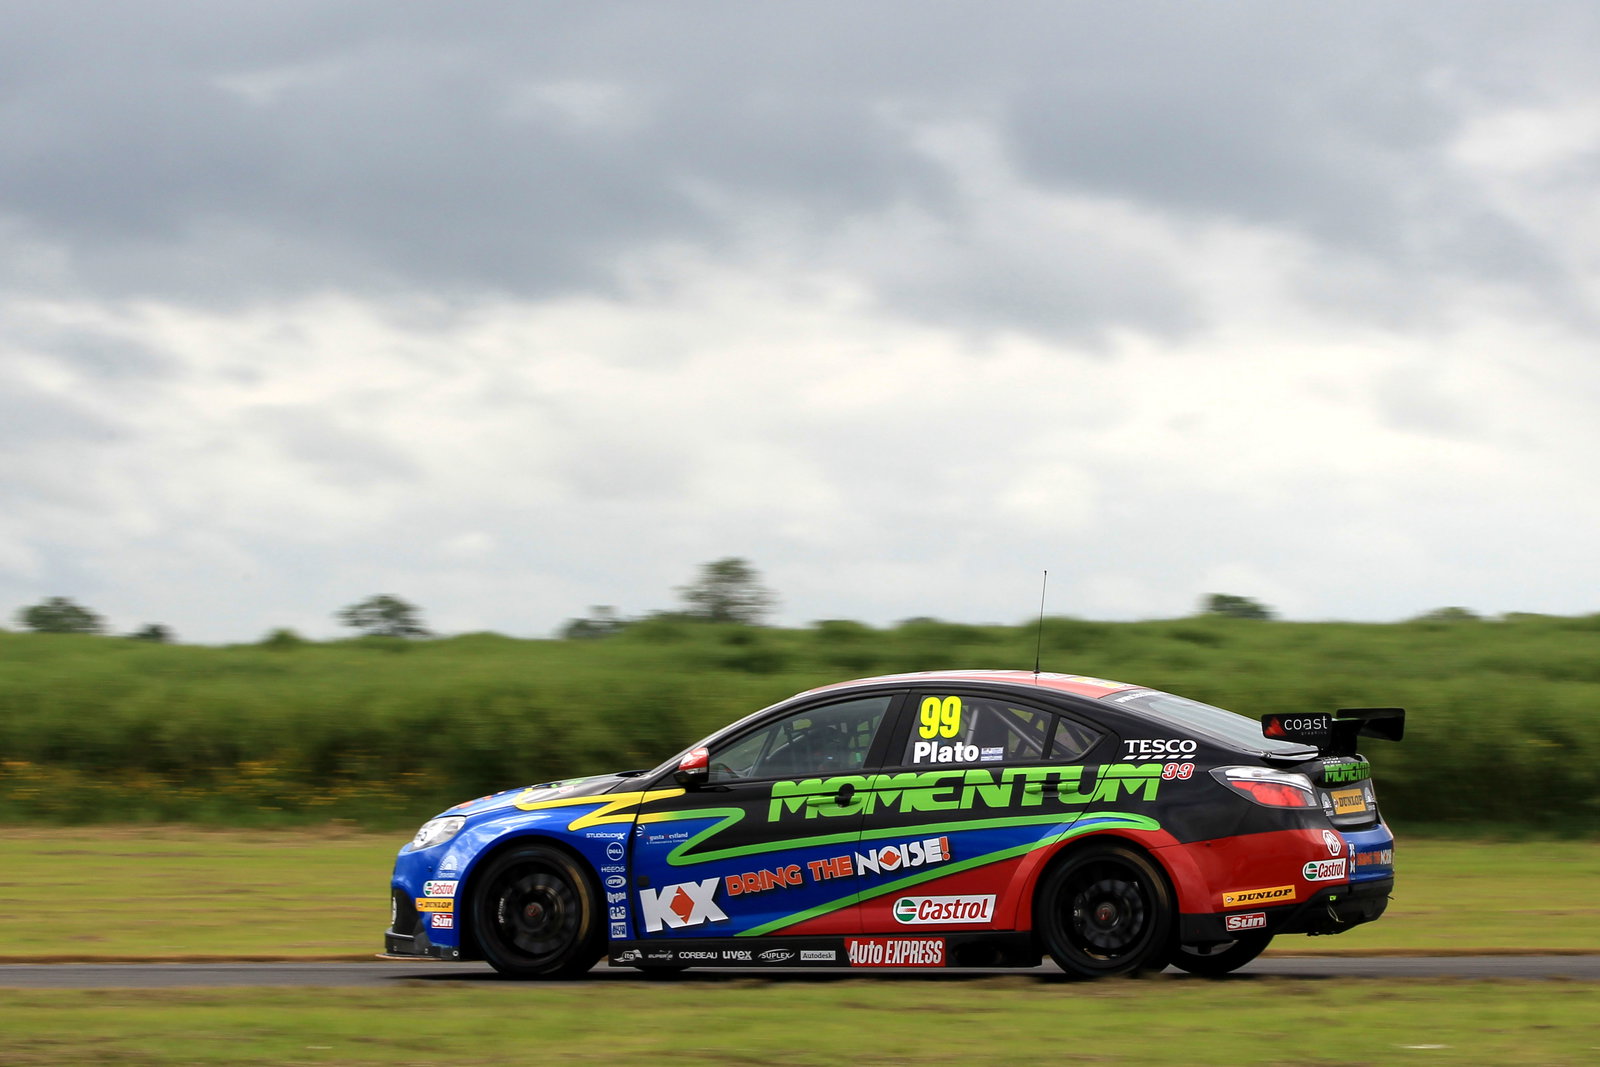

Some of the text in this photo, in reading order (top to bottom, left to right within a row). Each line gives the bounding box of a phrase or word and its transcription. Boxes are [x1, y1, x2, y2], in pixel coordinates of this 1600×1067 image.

[918, 695, 962, 739] 99
[1284, 715, 1328, 730] coast
[913, 741, 979, 764] Plato
[1123, 739, 1197, 754] TESCO
[1161, 762, 1195, 781] 99
[767, 763, 1163, 823] MOMENTUM
[1338, 794, 1363, 808] DUNLOP
[725, 835, 951, 897] BRING THE NOISE!
[1318, 861, 1344, 878] Castrol
[432, 883, 456, 895] Castrol
[1237, 889, 1293, 902] DUNLOP
[424, 901, 452, 909] DUNLOP
[639, 877, 729, 933] KX
[918, 898, 988, 921] Castrol
[432, 914, 453, 928] Sun
[1228, 916, 1265, 930] Sun
[678, 951, 718, 960] CORBEAU
[722, 949, 753, 961] uvex
[760, 952, 791, 960] SUPLEX
[801, 952, 834, 960] Autodesk
[849, 940, 943, 964] Auto EXPRESS
